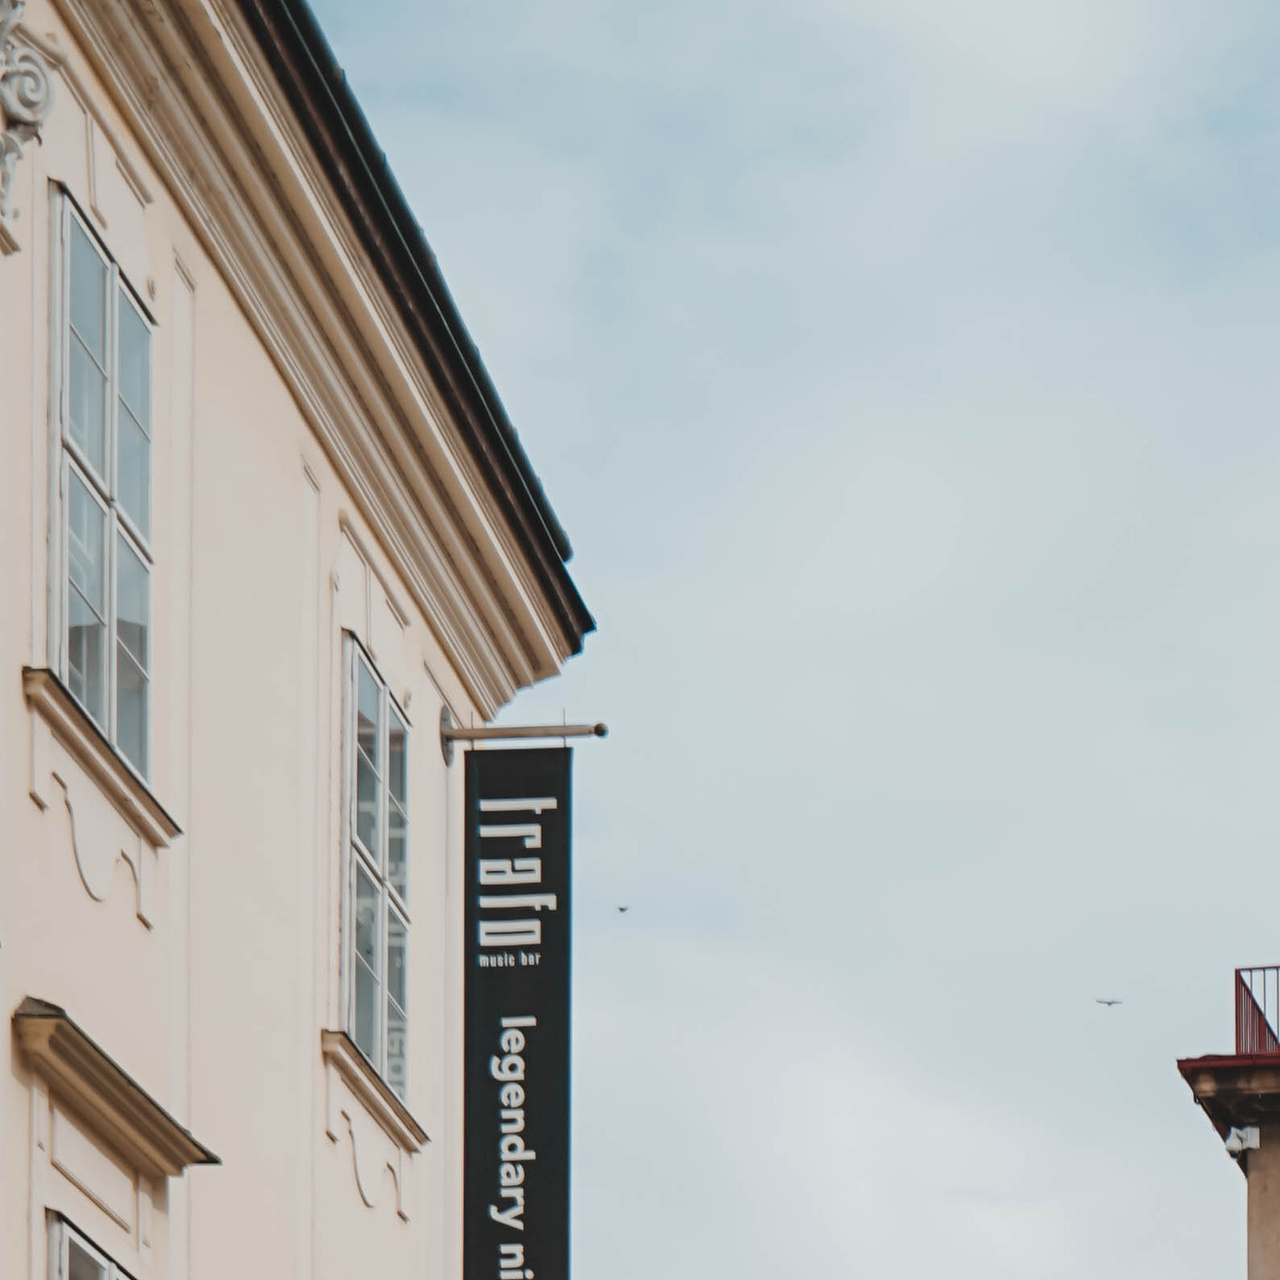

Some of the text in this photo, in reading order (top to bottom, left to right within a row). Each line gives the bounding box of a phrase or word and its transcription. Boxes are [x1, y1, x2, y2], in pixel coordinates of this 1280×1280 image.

[478, 797, 558, 946] trafo
[478, 950, 541, 967] music bar
[488, 1015, 538, 1230] legendary
